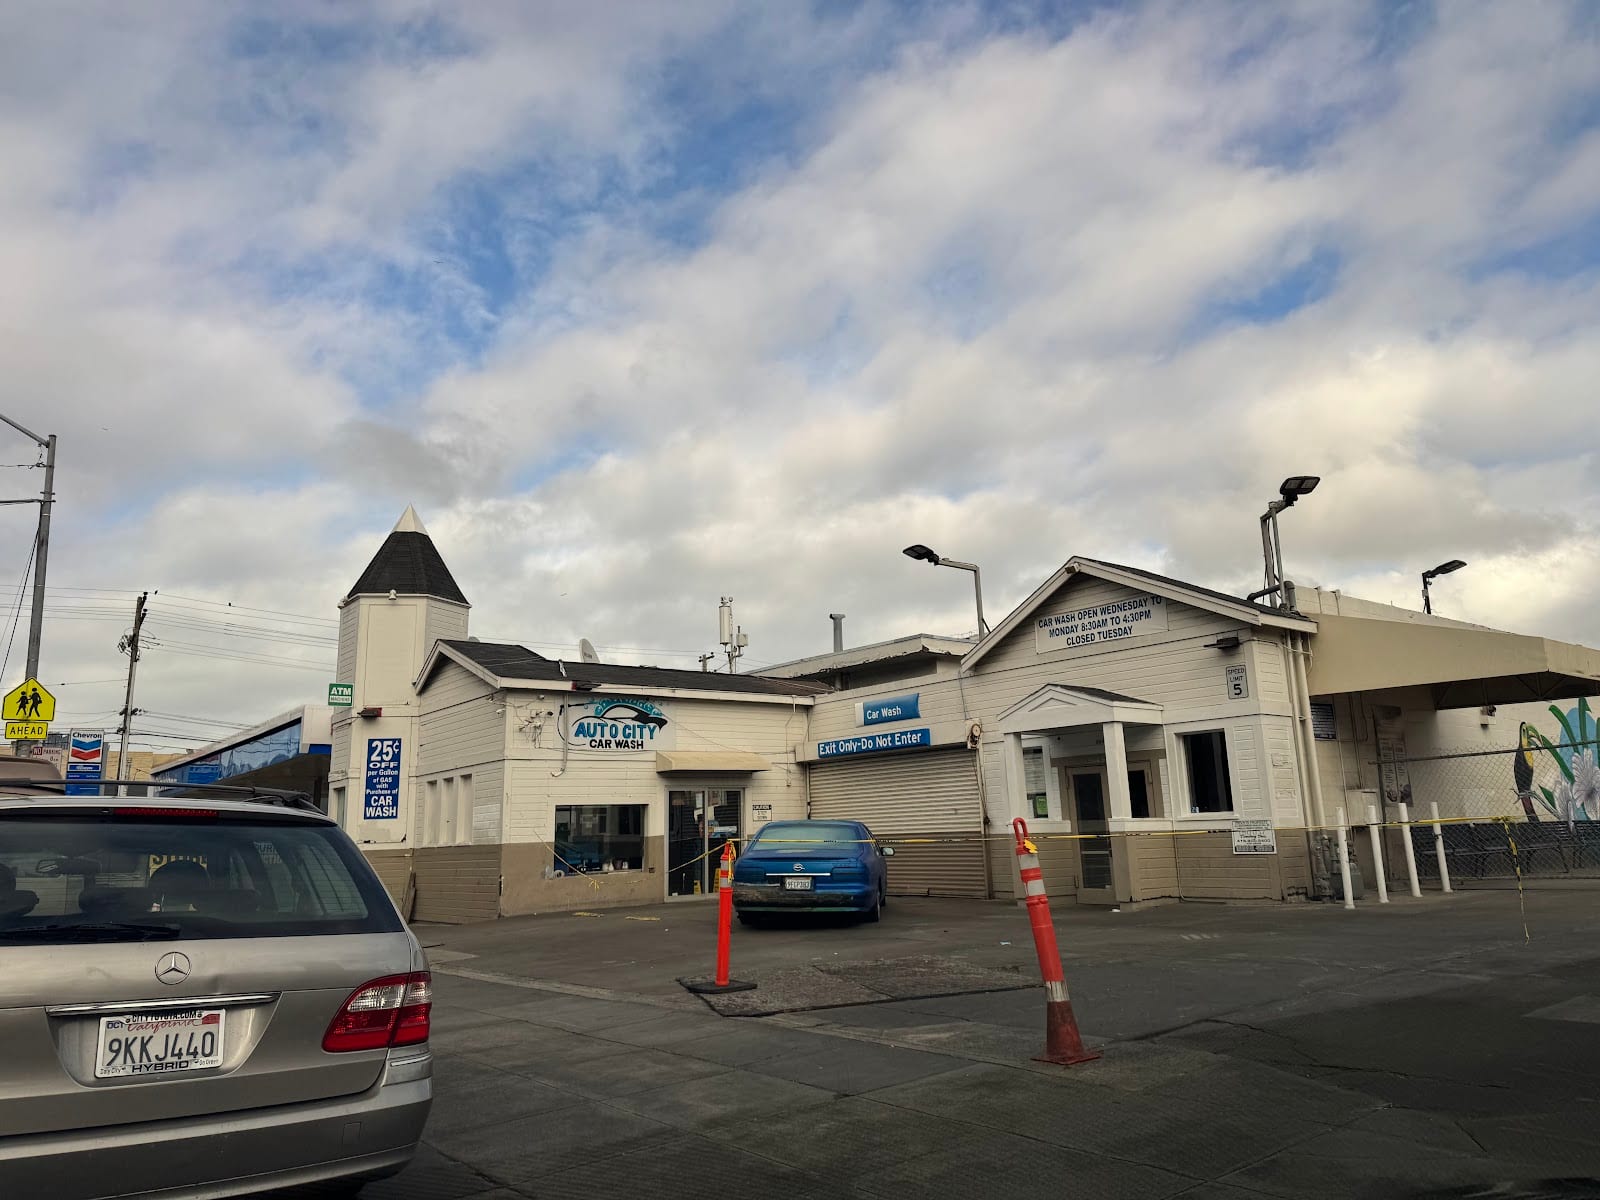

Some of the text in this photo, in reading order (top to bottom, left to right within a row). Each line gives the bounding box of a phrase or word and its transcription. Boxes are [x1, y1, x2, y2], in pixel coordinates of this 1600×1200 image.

[1038, 595, 1162, 629] CAR WASH OPEN WEDNESDAY TO
[1048, 609, 1152, 638] MONDAY 8:30AM TO 4:30PM
[1066, 625, 1133, 646] CLOSED TUESDAY
[1227, 667, 1245, 675] SPEED
[331, 687, 351, 695] ATM
[1233, 683, 1242, 696] 5
[866, 705, 902, 720] Car Wash
[10, 727, 43, 735] AHEAD
[574, 721, 657, 740] AUTO CITY
[589, 739, 644, 749] CAR WASH
[819, 742, 837, 755] Exit
[876, 734, 892, 747] Not
[894, 732, 922, 746] Enter
[33, 747, 42, 755] NO
[367, 769, 378, 777] per
[371, 796, 393, 807] CAR
[365, 806, 397, 818] WASH
[106, 1021, 123, 1030] OCT
[127, 1019, 199, 1034] California
[106, 1031, 215, 1067] 9KKJ440
[131, 1060, 189, 1073] HYBRID
